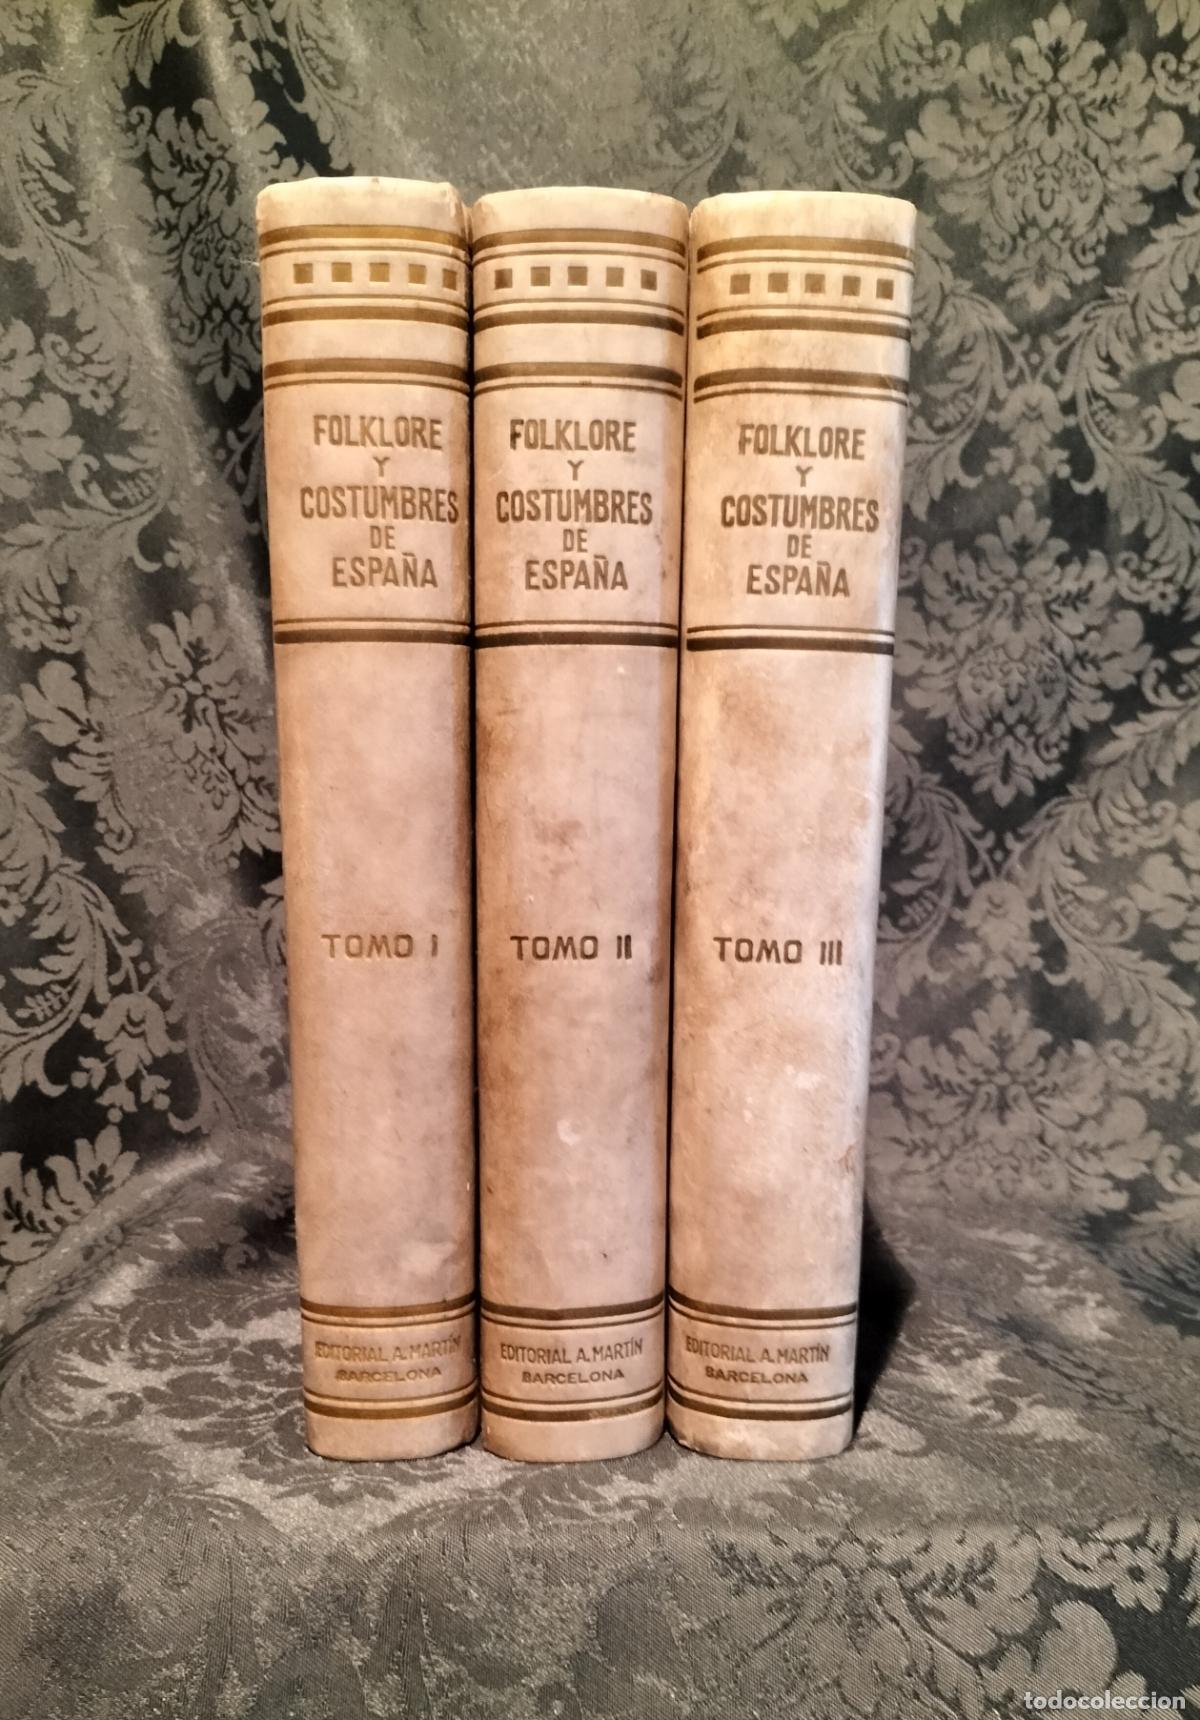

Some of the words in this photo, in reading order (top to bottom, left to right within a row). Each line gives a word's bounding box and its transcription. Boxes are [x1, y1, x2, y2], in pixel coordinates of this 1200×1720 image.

[313, 414, 443, 450] FOLKLORE
[510, 418, 637, 452] FOLKLORE
[738, 423, 867, 461] FOLKLORE
[373, 456, 390, 478] Y
[567, 460, 584, 481] Y
[795, 465, 813, 488] Y
[300, 485, 460, 524] COSTUMBRES
[496, 488, 653, 526] COSTUMBRES
[720, 493, 880, 533] COSTUMBRES
[370, 525, 396, 550] DE
[562, 528, 588, 553] DE
[786, 533, 812, 559] DE
[332, 551, 438, 588] ESPAÑA
[525, 554, 629, 591] ESPAÑA
[746, 560, 850, 598] ESPAÑA
[321, 933, 414, 959] TOMO
[431, 933, 438, 958] I
[510, 935, 599, 961] TOMO
[616, 934, 632, 960] II
[713, 936, 803, 964] TOMO
[819, 939, 843, 966] III
[314, 1340, 389, 1362] EDITORIAL
[500, 1342, 572, 1365] EDITORIAL
[686, 1335, 756, 1363] EDITORIAL
[335, 1366, 442, 1383] BARCELONA
[522, 1369, 625, 1385] BARCELONA
[705, 1365, 808, 1384] BARCELONA
